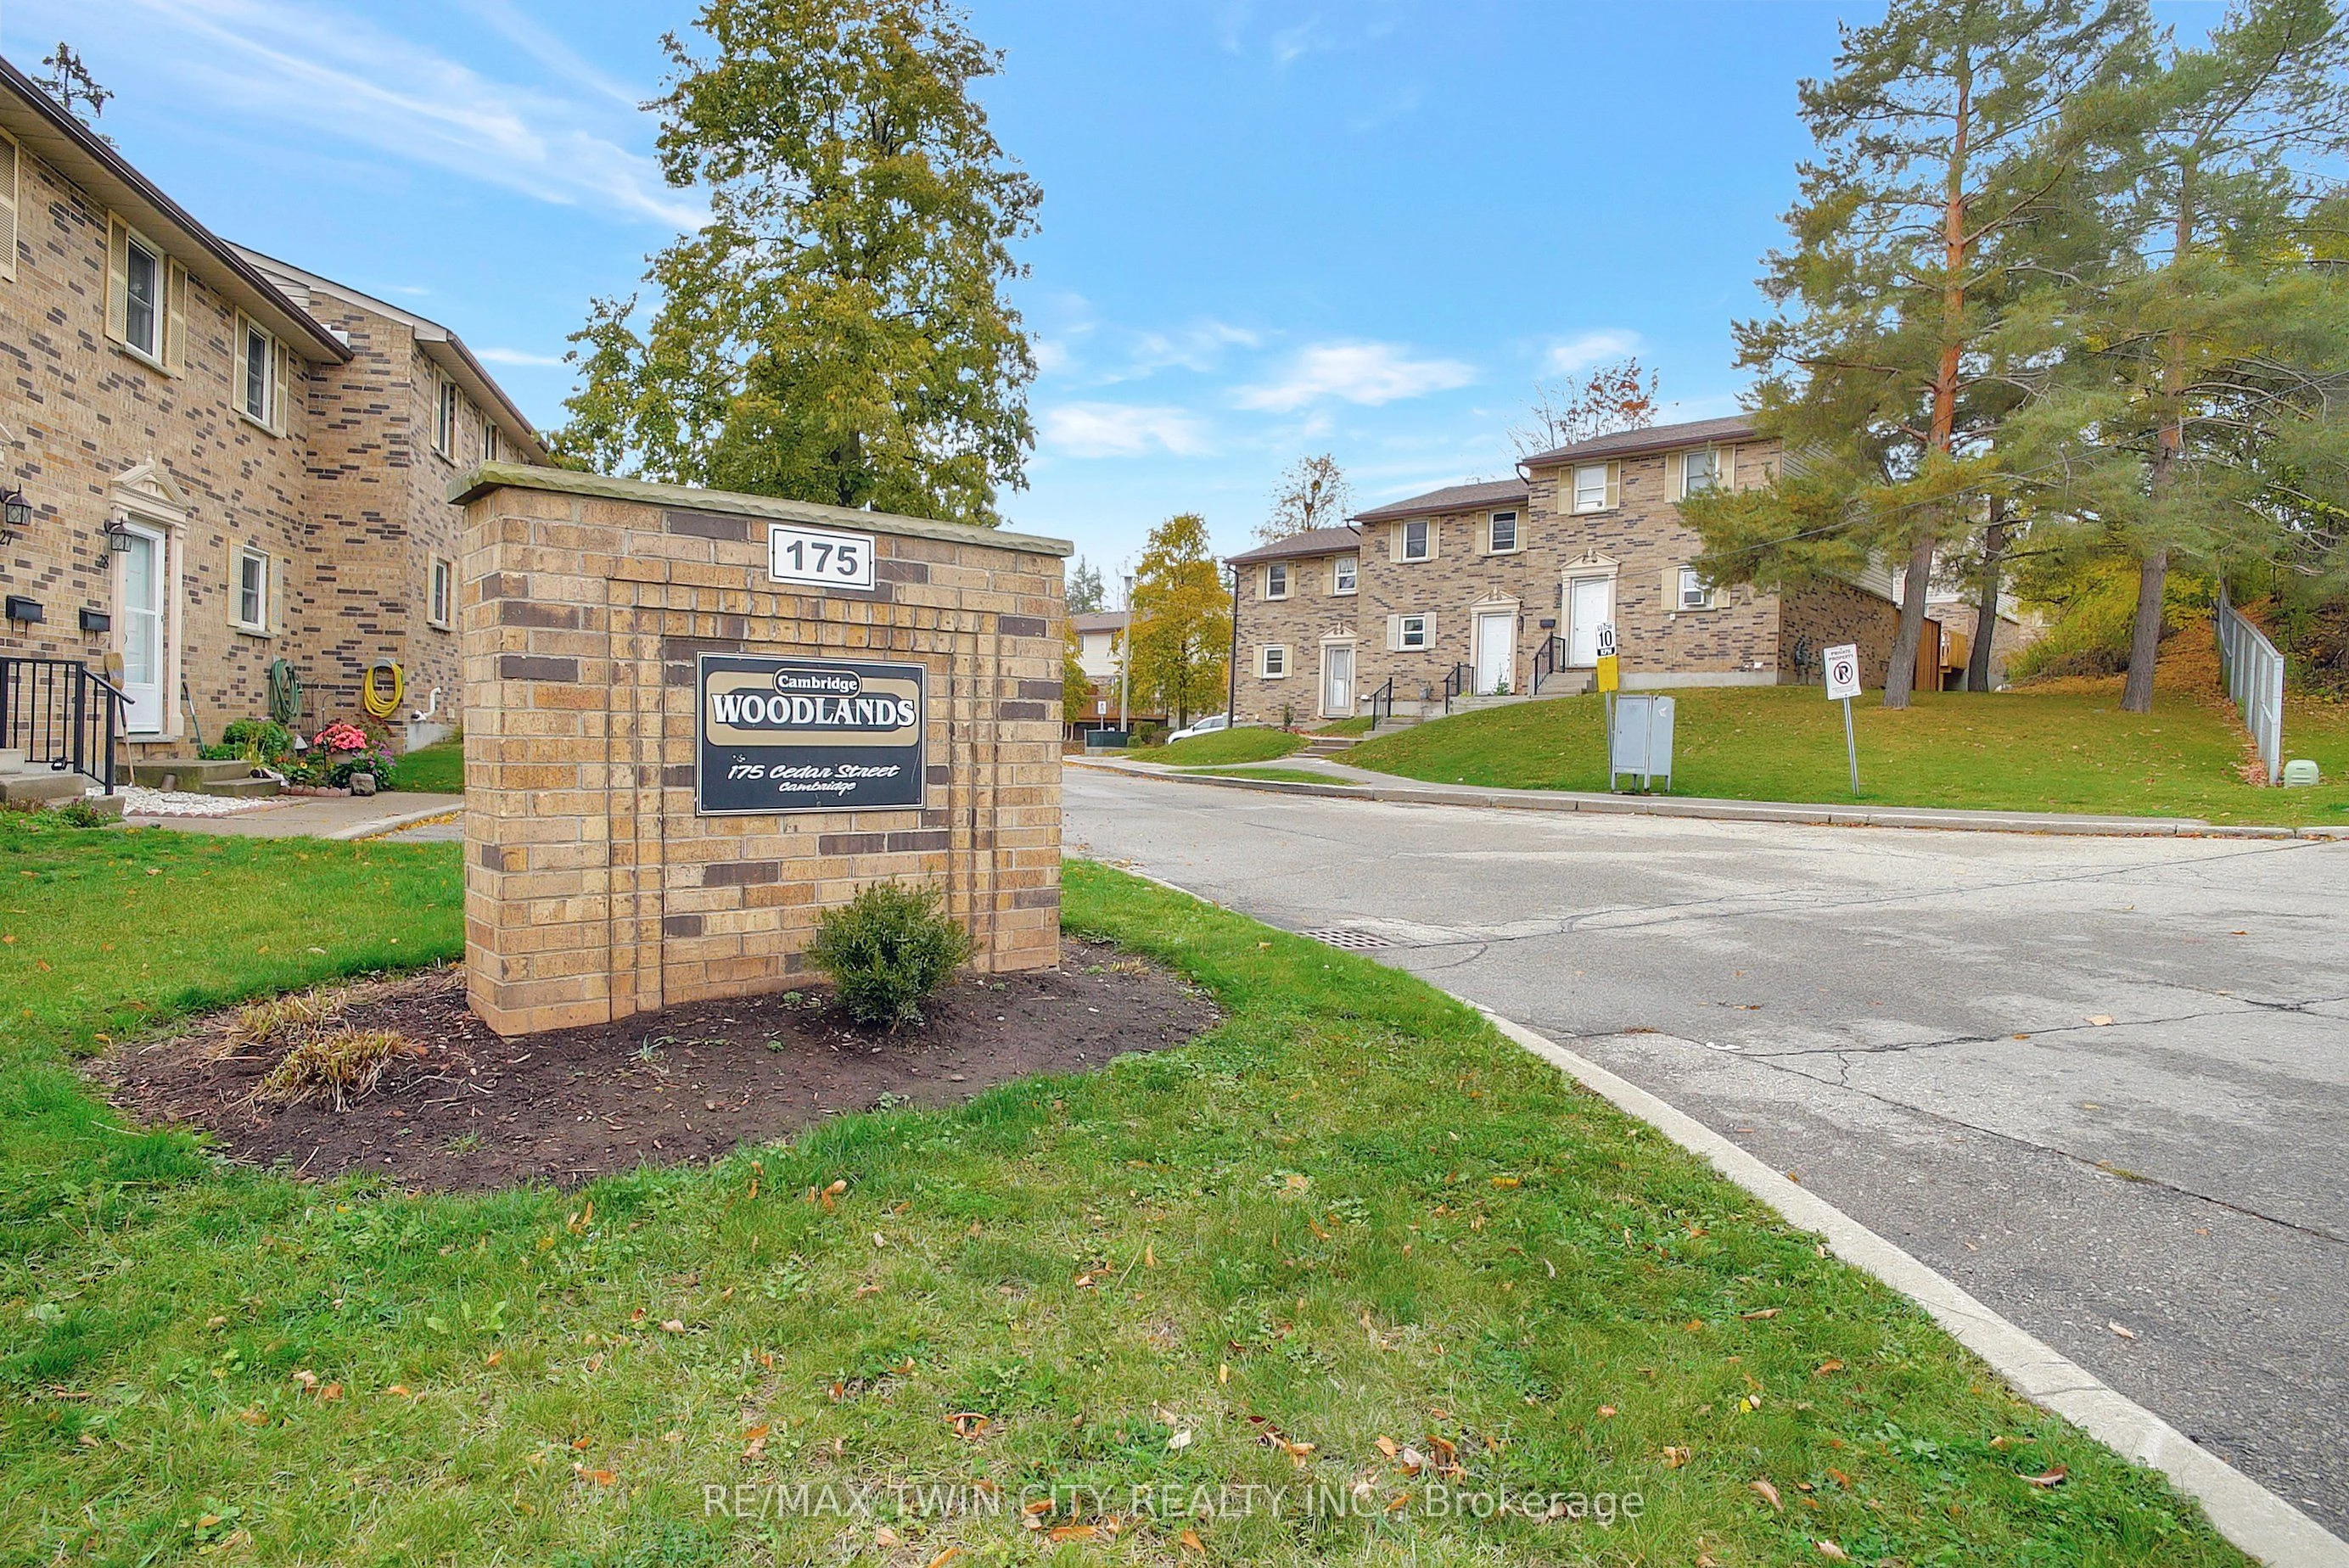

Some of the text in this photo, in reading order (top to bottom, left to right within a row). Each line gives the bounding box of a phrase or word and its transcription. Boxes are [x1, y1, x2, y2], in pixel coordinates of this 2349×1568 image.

[0, 529, 14, 546] 27
[787, 540, 858, 576] 175
[1599, 630, 1612, 647] 10
[777, 675, 858, 693] Cambridge
[711, 693, 917, 726] WOODLANDS
[727, 764, 901, 780] 175 Cedar Street
[778, 781, 856, 797] Cambridge
